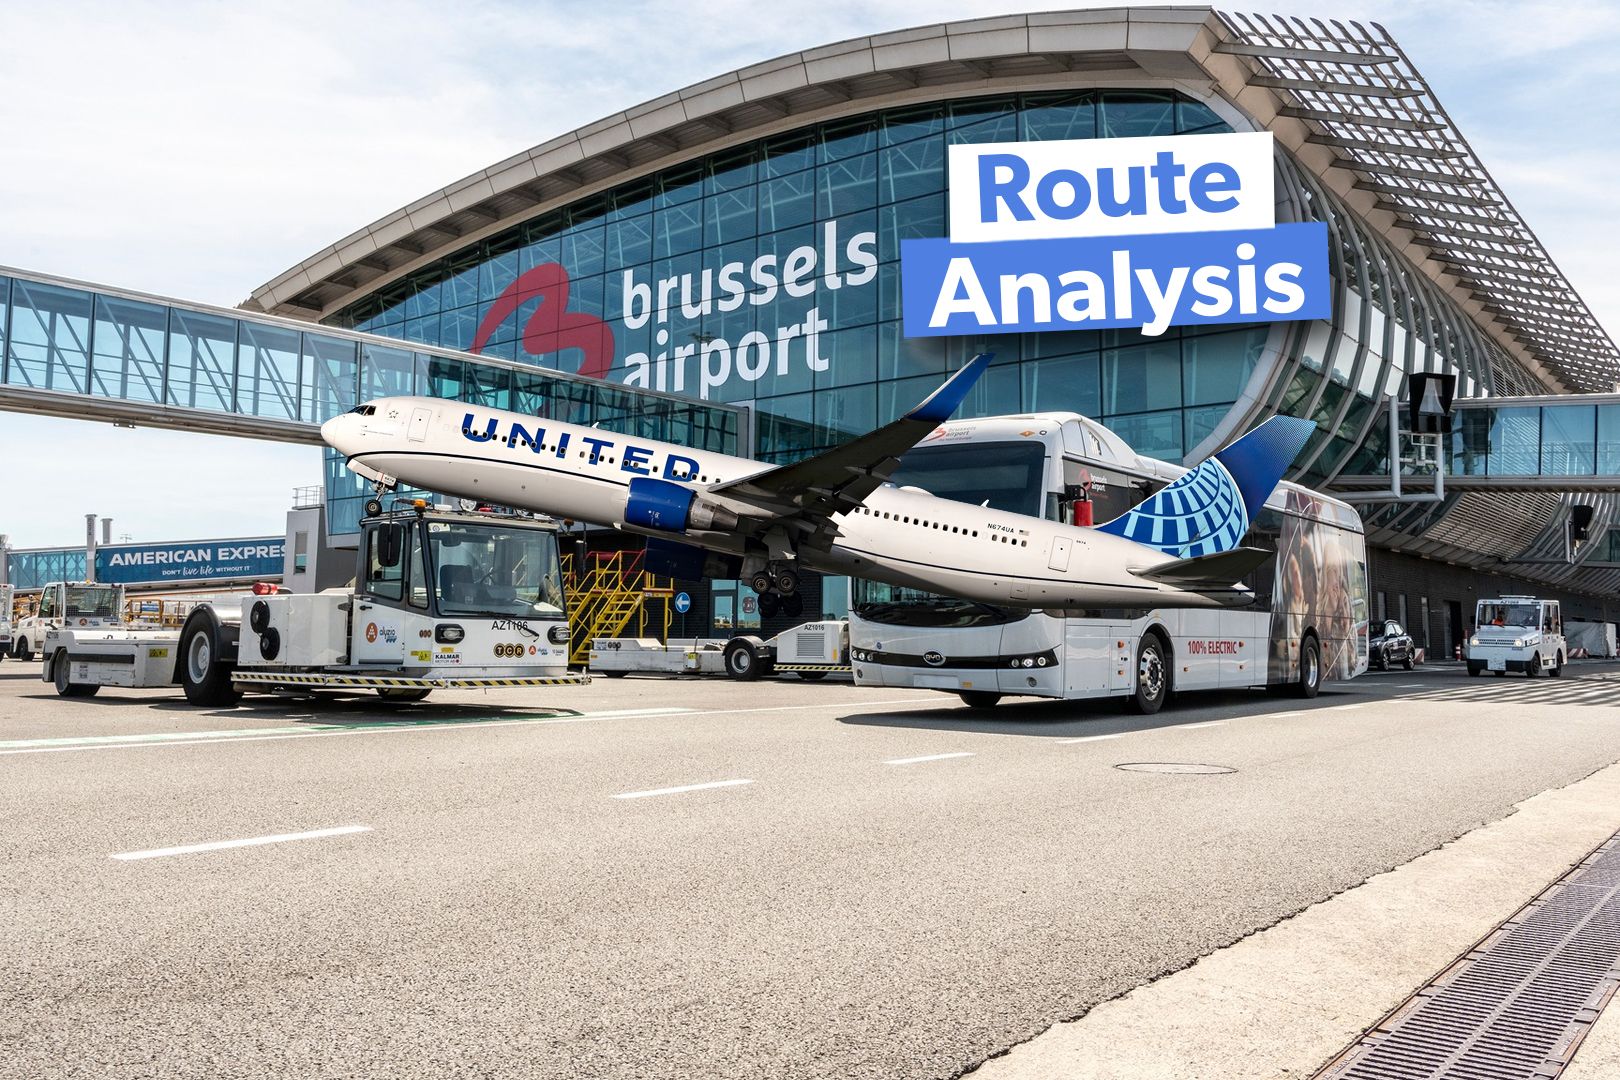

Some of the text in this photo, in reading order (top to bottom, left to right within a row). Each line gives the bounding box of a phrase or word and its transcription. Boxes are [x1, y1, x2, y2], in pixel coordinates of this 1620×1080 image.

[622, 220, 879, 331] brussels
[622, 306, 830, 401] airport
[461, 412, 701, 484] UNITED
[987, 523, 1015, 534] N674UA
[109, 548, 211, 567] AMERICAN
[182, 566, 199, 577] live
[199, 565, 214, 576] life
[491, 620, 528, 631] AZ1106
[495, 645, 524, 656] TCR
[1188, 640, 1238, 655] 100% ELECTRIC
[924, 653, 942, 661] BYD
